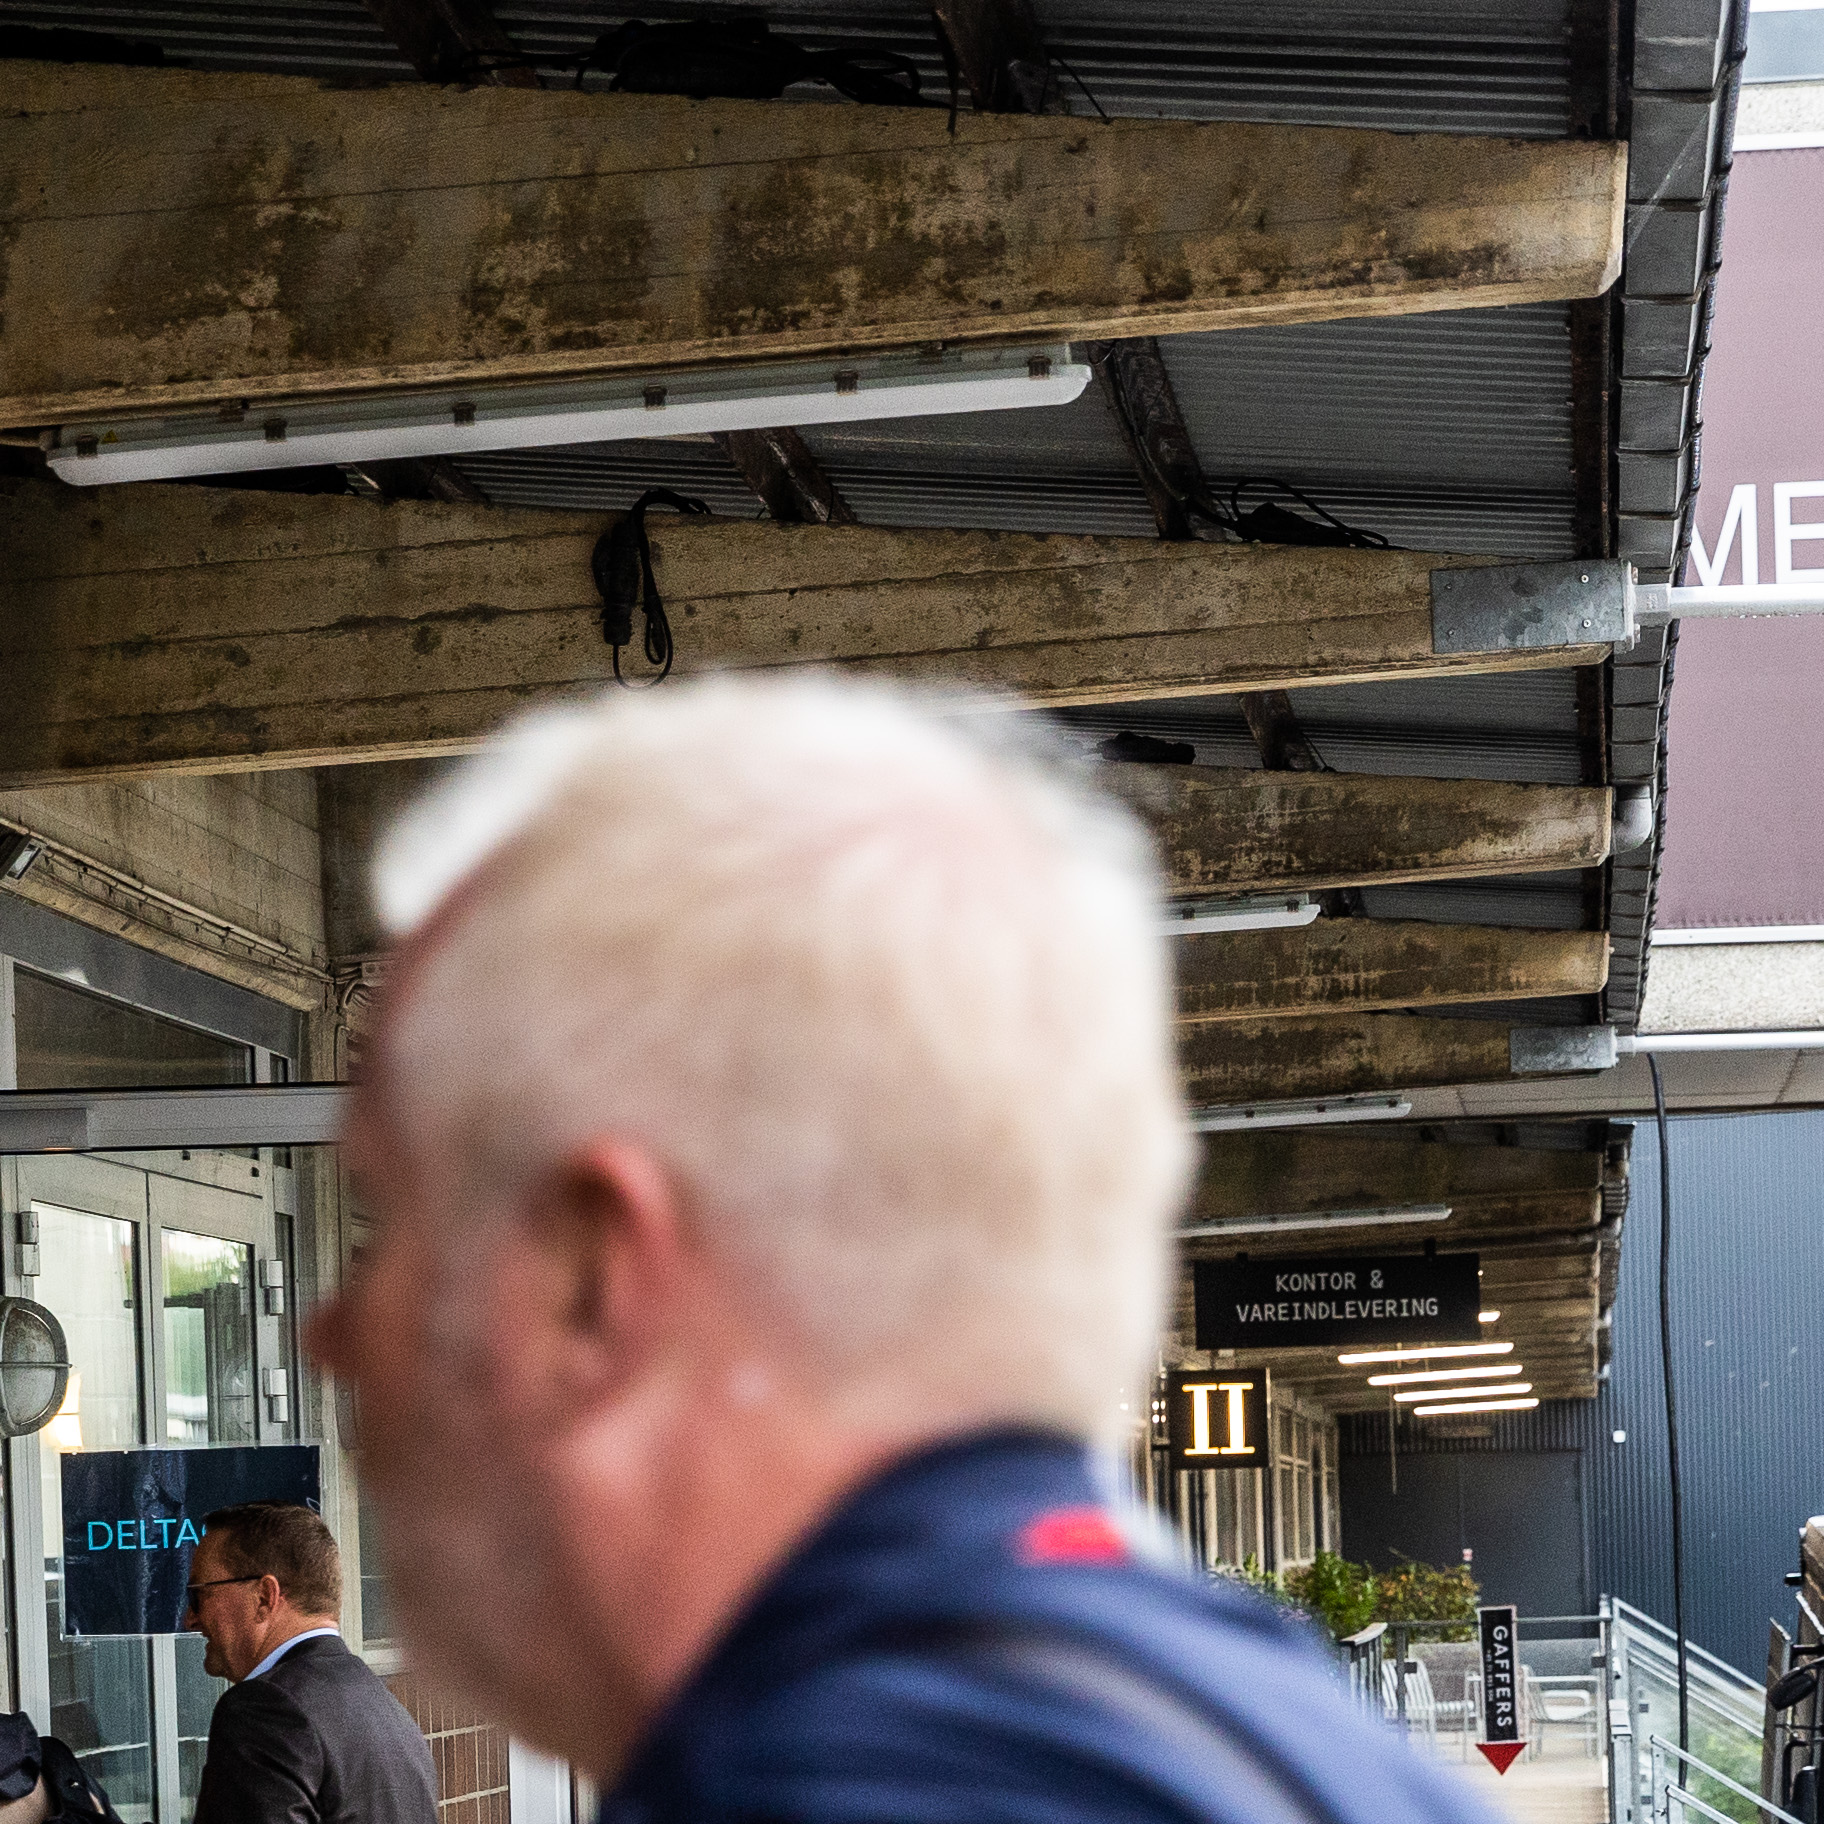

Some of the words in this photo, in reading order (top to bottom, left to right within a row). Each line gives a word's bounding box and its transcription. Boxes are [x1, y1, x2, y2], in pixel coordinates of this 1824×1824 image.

[1275, 1272, 1357, 1293] KONTOR
[1369, 1269, 1384, 1289] &
[1236, 1297, 1439, 1323] VAREINDLEVERING
[87, 1518, 207, 1551] DELTA
[1492, 1625, 1513, 1727] GAFFERS
